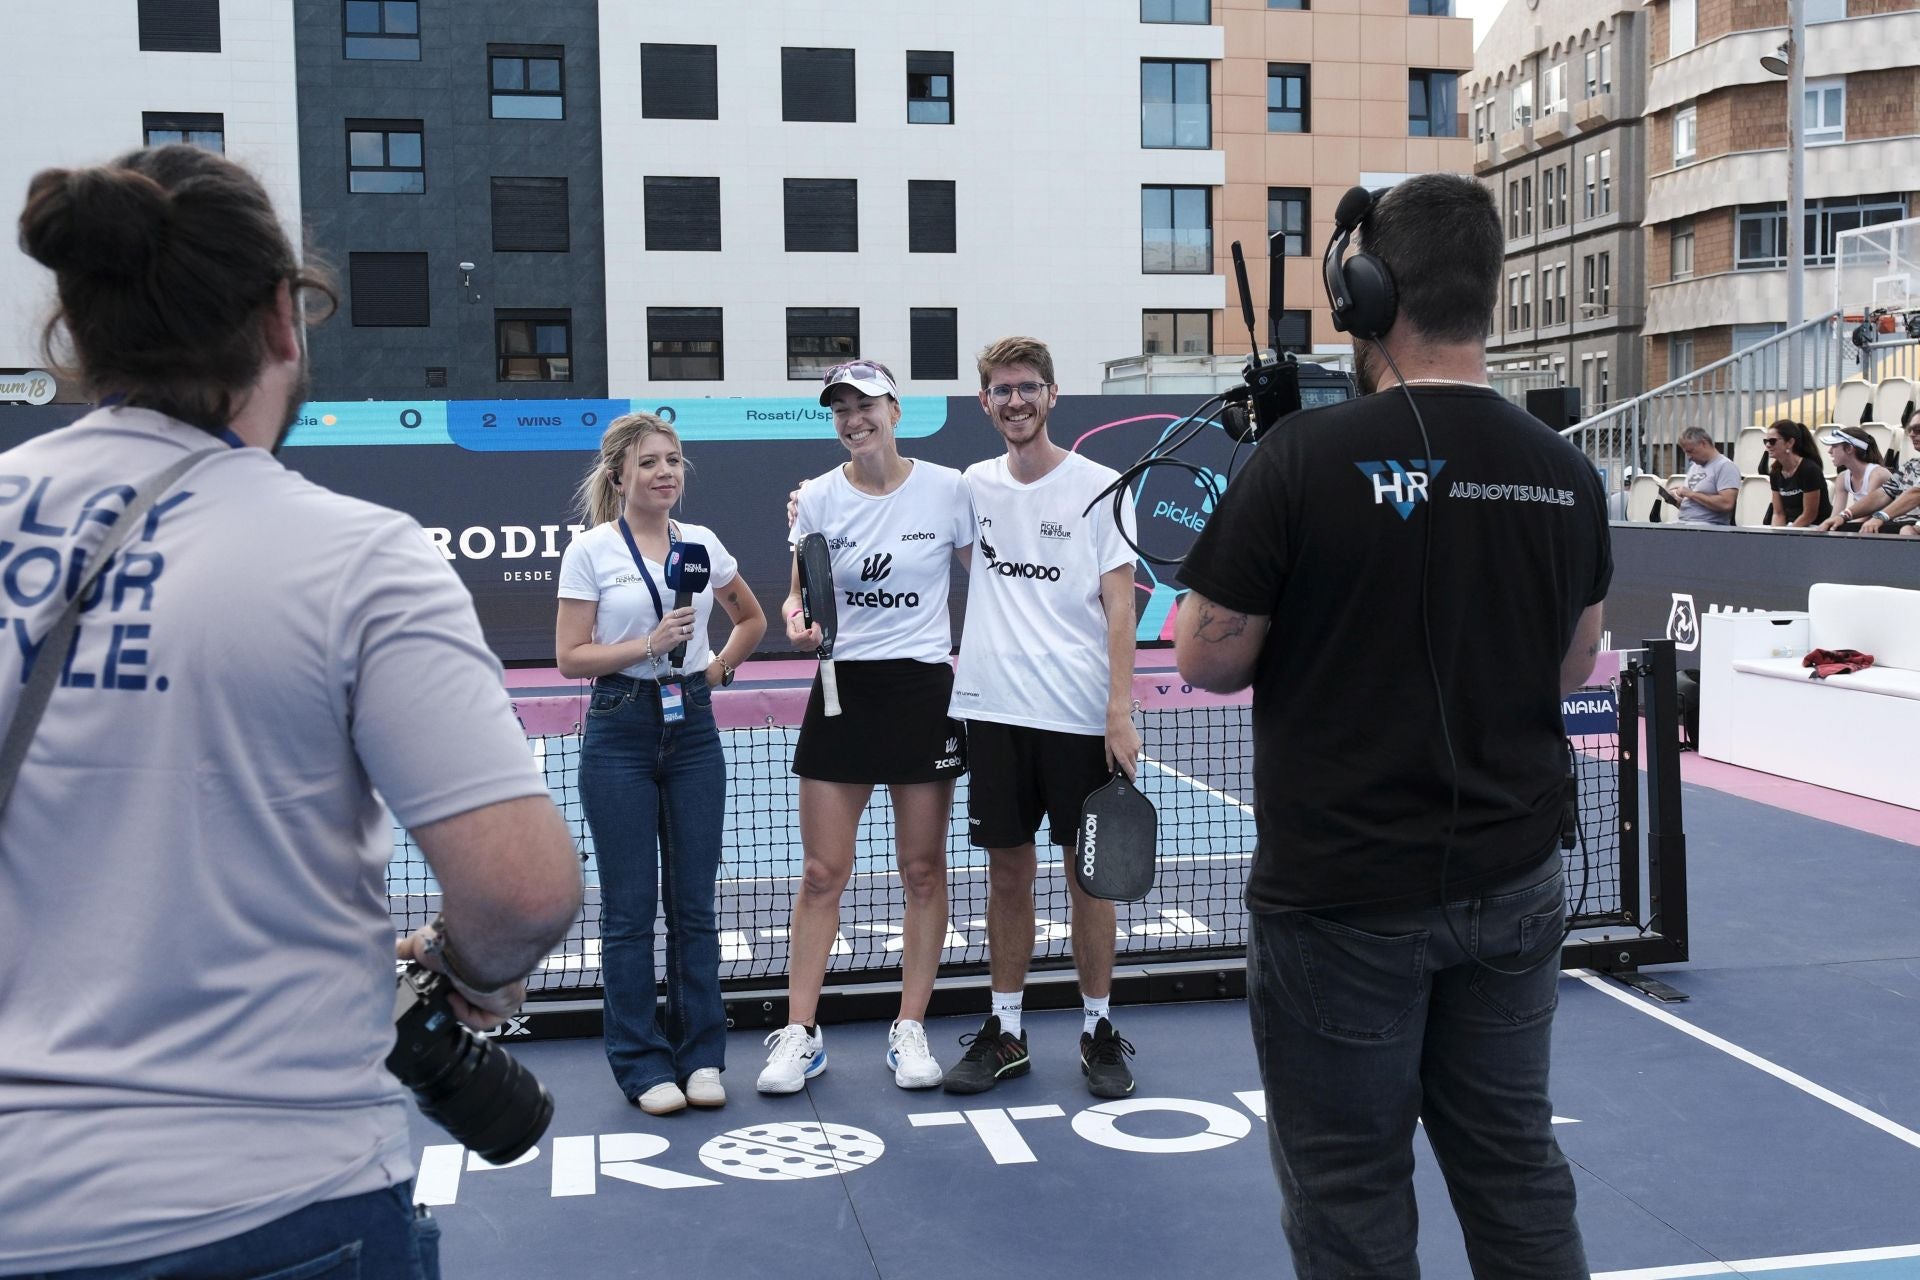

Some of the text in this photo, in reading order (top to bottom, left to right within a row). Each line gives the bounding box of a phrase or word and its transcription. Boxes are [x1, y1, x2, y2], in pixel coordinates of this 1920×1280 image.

[28, 378, 48, 398] 18
[482, 413, 497, 428] 2
[517, 416, 563, 427] WINS
[1372, 471, 1575, 506] HR AUDIOVISUALES
[1153, 500, 1206, 533] pickle
[901, 532, 936, 542] zcebra
[504, 571, 553, 582] DESDE
[844, 588, 920, 609] zcebra
[0, 617, 169, 692] YLE.
[1561, 699, 1614, 715] NARIA
[1083, 813, 1098, 877] KOMODO
